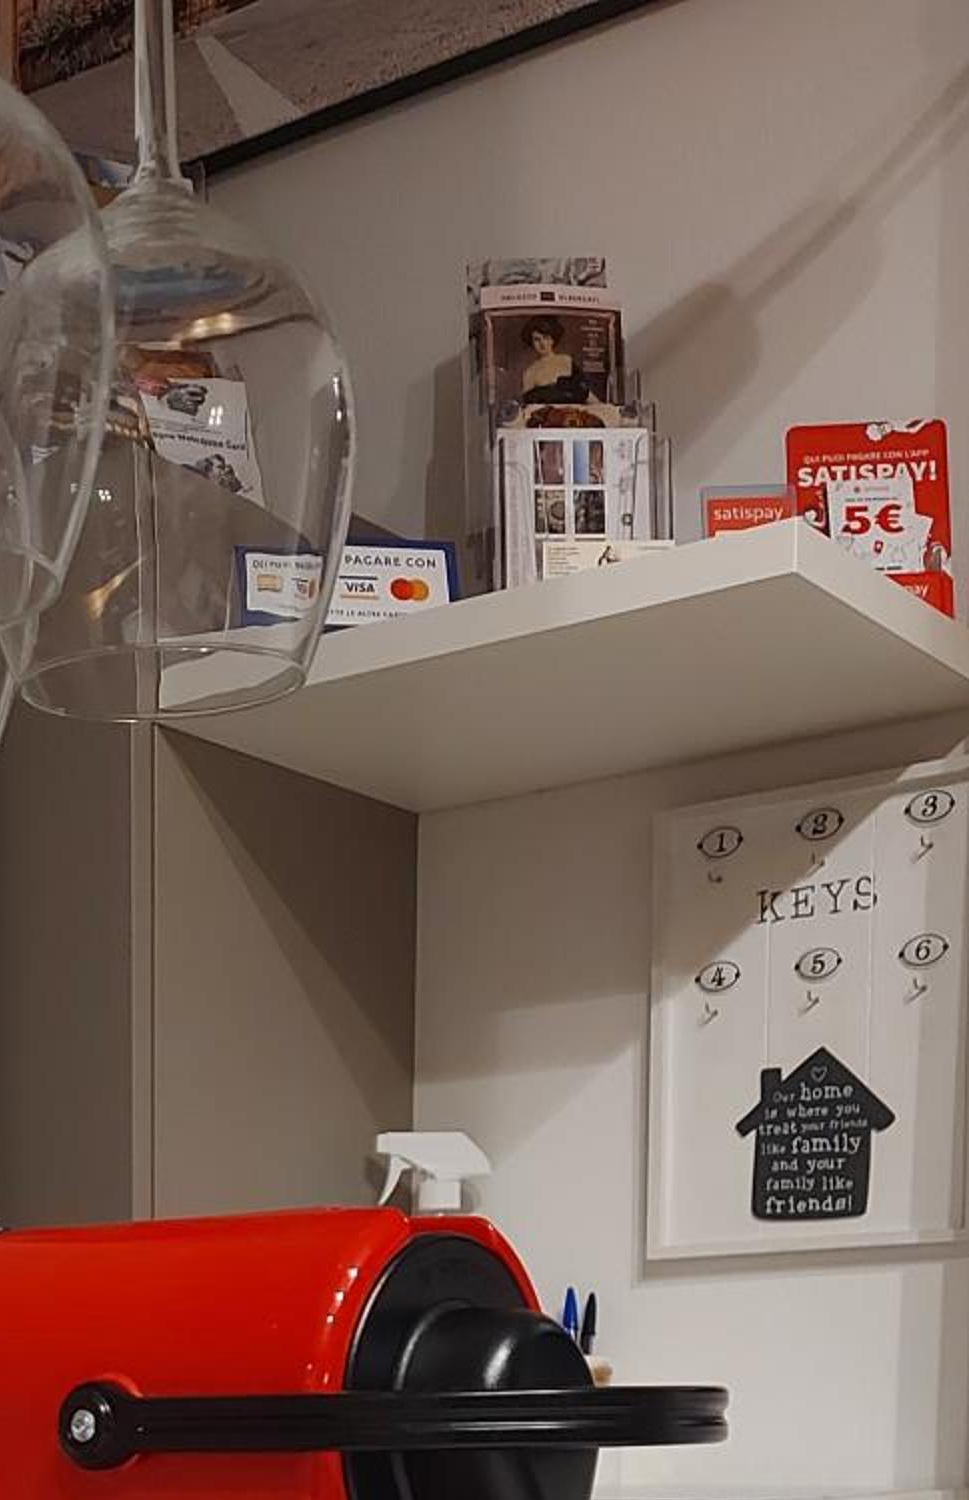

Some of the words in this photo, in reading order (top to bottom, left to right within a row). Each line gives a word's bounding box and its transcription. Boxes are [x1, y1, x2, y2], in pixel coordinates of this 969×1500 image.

[797, 460, 937, 488] SATISPAY!
[713, 505, 784, 525] satispay
[841, 503, 904, 535] 5€
[344, 554, 402, 568] PAGARE
[406, 556, 437, 569] CON
[345, 580, 376, 593] VISA
[921, 795, 938, 817] 3
[811, 814, 828, 835] 2
[757, 875, 878, 925] KEYS
[914, 940, 932, 961] 6
[809, 954, 826, 975] 5
[710, 966, 725, 987] 4
[773, 1091, 795, 1103] Our
[800, 1082, 854, 1102] home
[764, 1107, 778, 1120] is
[787, 1104, 829, 1118] where
[836, 1103, 860, 1118] you
[758, 1121, 798, 1136] treat
[800, 1121, 825, 1133] your
[828, 1118, 868, 1130] friends
[760, 1143, 786, 1156] like
[791, 1132, 862, 1155] family
[771, 1158, 798, 1172] and
[807, 1157, 846, 1174] your
[765, 1176, 815, 1193] family
[822, 1175, 854, 1191] like
[765, 1194, 853, 1214] friends!
